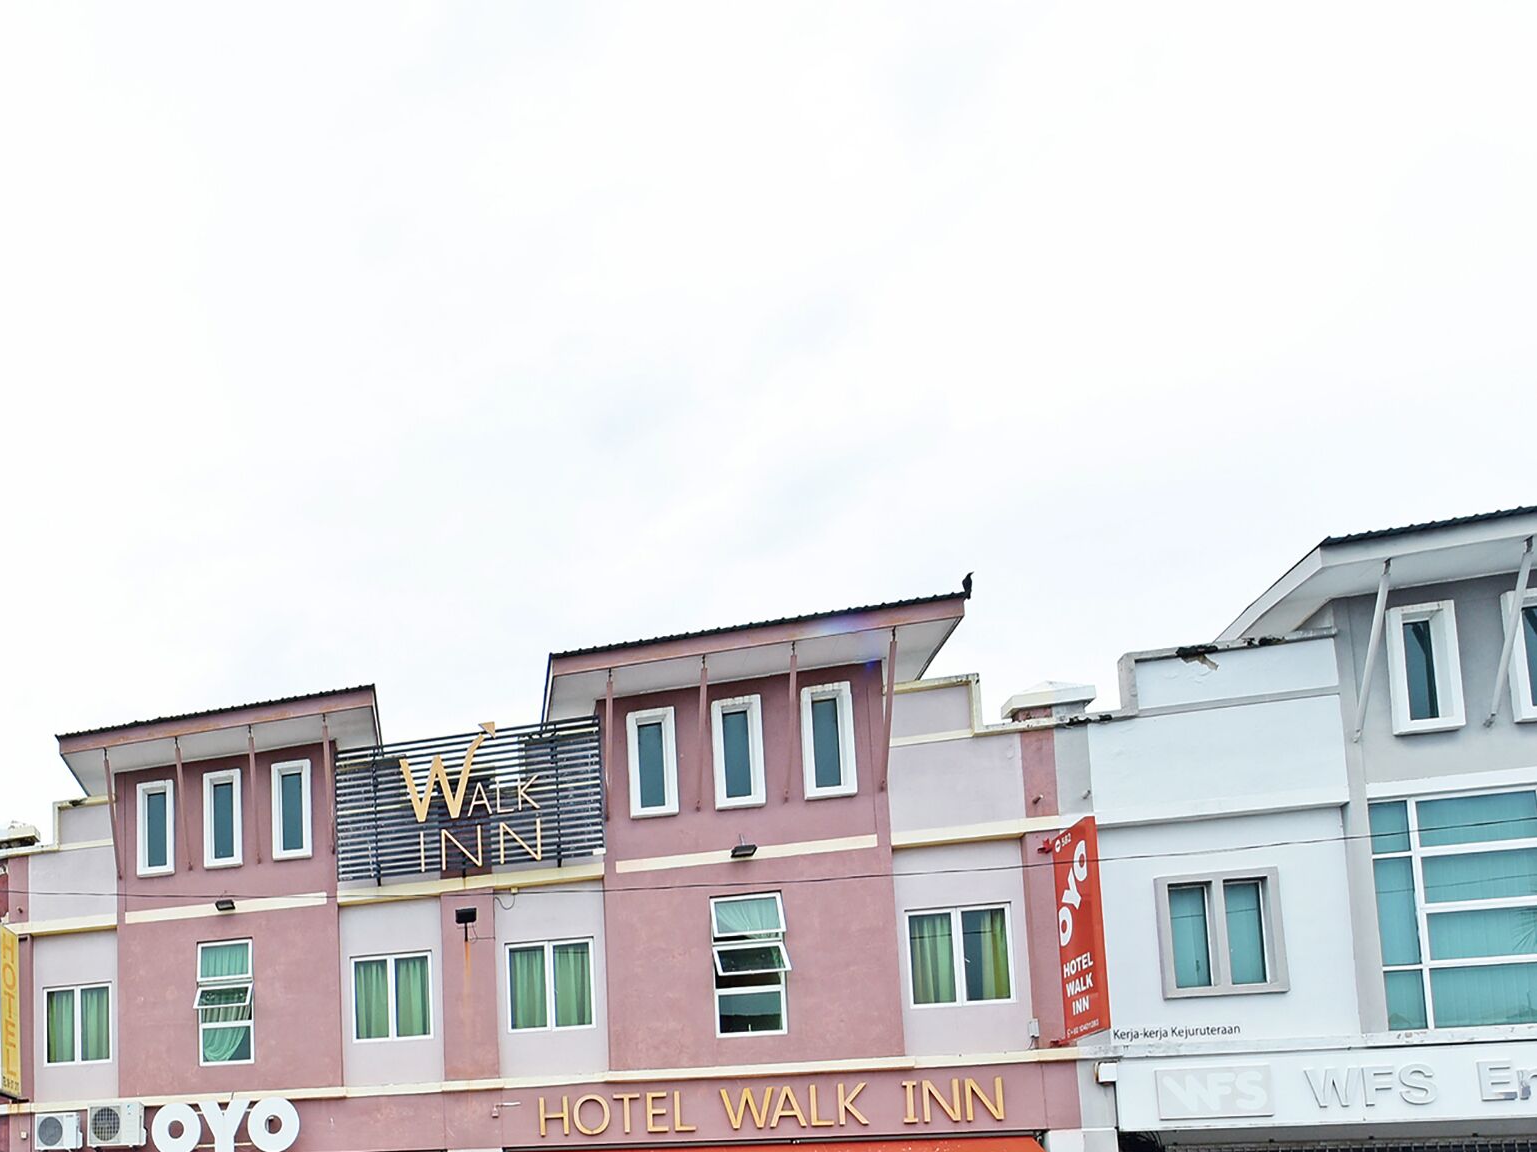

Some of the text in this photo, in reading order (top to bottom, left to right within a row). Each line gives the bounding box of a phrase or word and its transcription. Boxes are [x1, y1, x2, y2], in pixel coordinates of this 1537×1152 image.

[399, 721, 541, 823] WALK
[419, 817, 542, 873] INN
[1058, 840, 1088, 947] OYO
[1063, 952, 1094, 979] HOTEL
[1065, 972, 1094, 998] WALK
[2, 933, 17, 1077] HOTEL
[1072, 996, 1090, 1016] INN
[1113, 1024, 1241, 1042] Kerja-kerja Kejuruteraan
[538, 1075, 1005, 1137] HOTEL WALK INN
[1303, 1063, 1438, 1109] WFS
